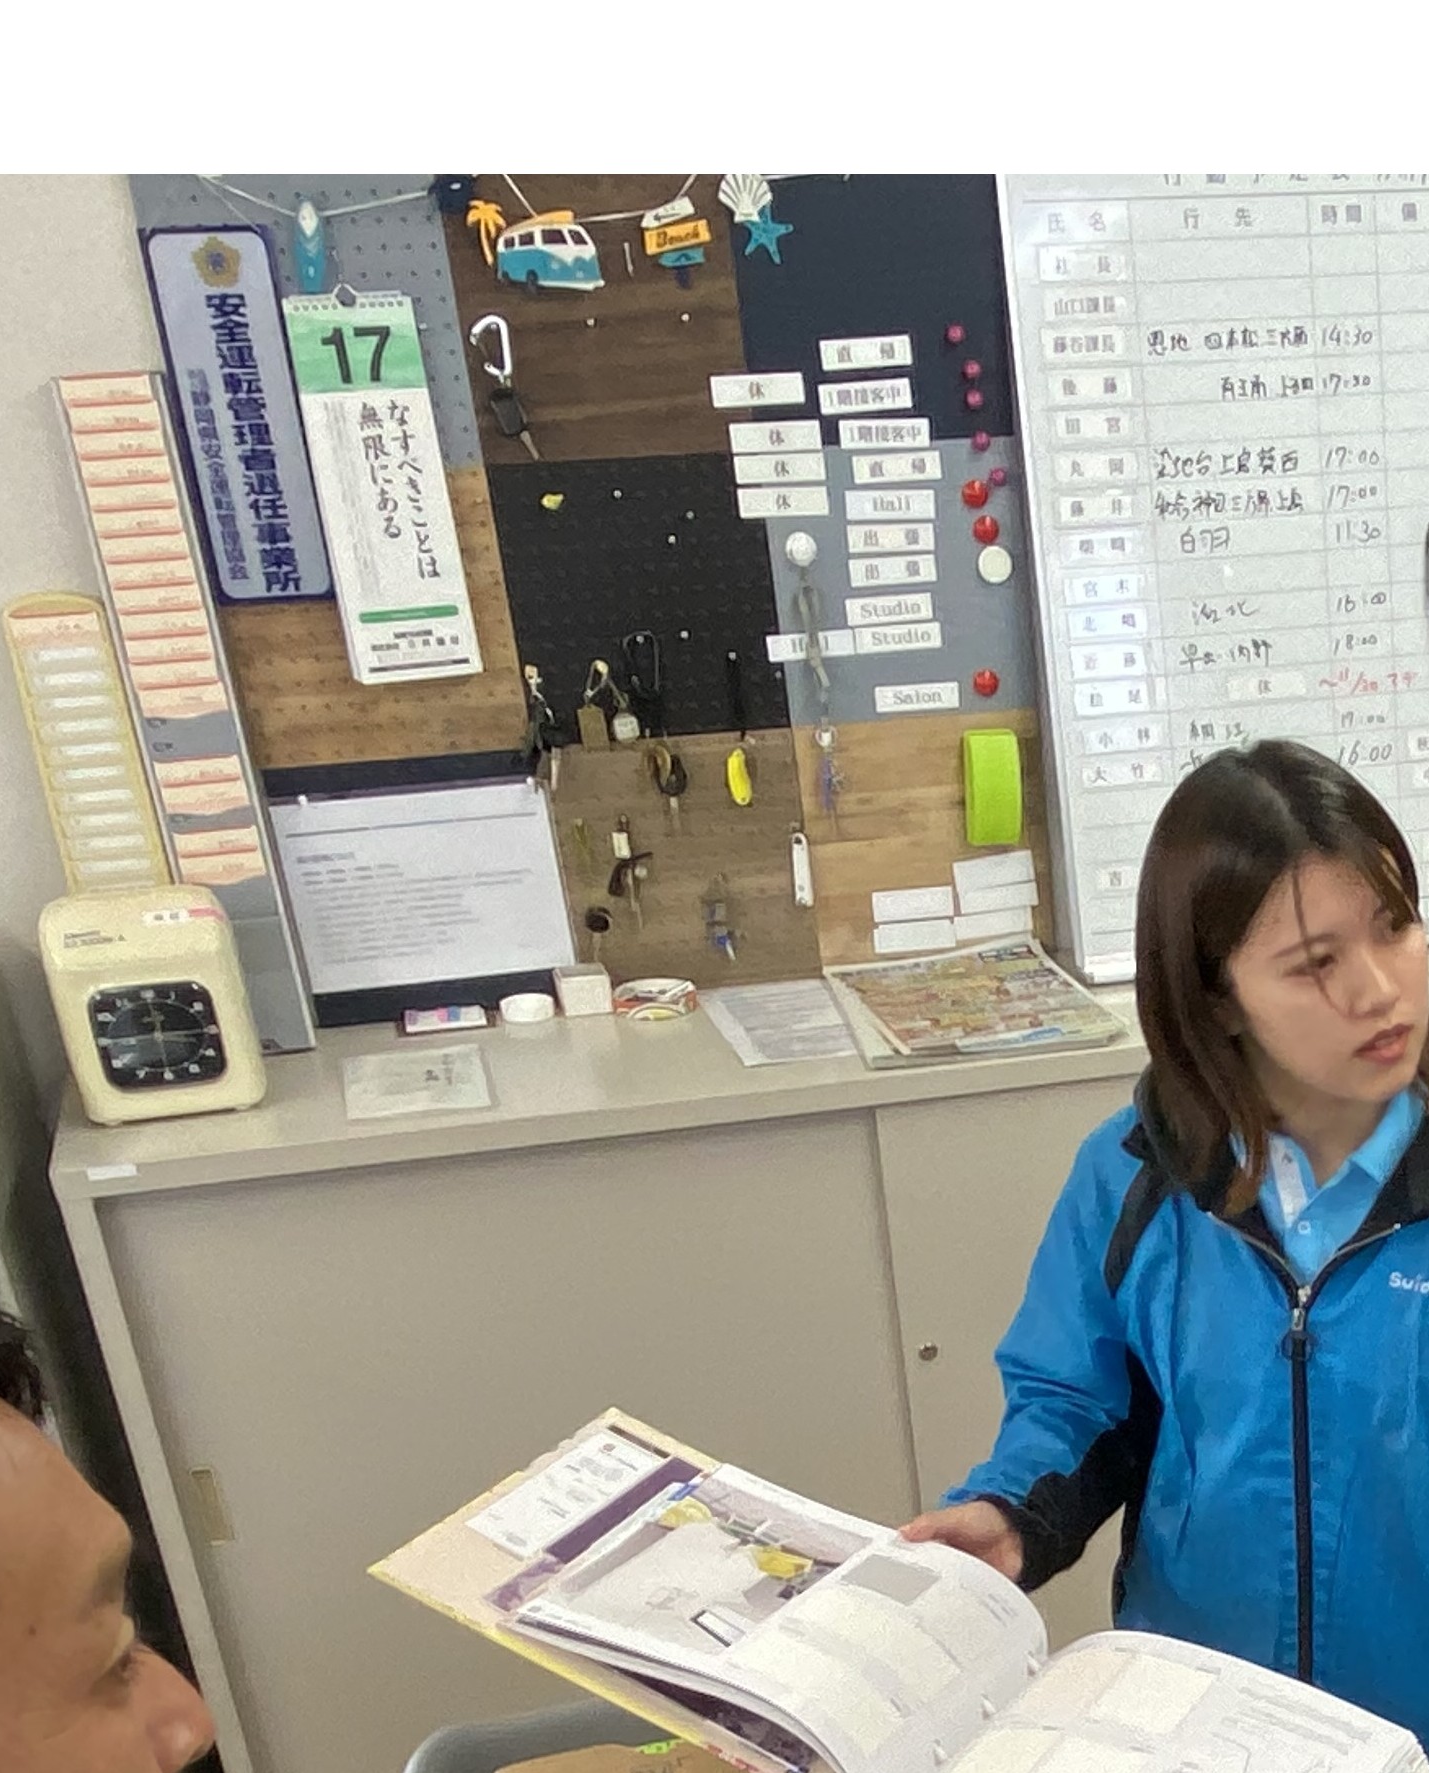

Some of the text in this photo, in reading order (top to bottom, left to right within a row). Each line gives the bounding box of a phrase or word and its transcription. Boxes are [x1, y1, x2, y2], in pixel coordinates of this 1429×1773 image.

[1322, 324, 1373, 347] 14:30
[321, 326, 392, 384] 17
[749, 382, 765, 398] 休
[769, 430, 785, 447] 休
[1325, 447, 1380, 469] 17:00
[359, 402, 402, 539] 無限にある
[773, 460, 790, 477] 休
[388, 400, 441, 580] なすべきことは
[1327, 486, 1378, 509] 17:00
[775, 494, 791, 510] 休
[872, 497, 912, 513] Hall
[860, 600, 922, 617] Studio
[791, 635, 830, 654] Hl
[871, 629, 931, 645] Studio
[892, 689, 943, 705] Salon
